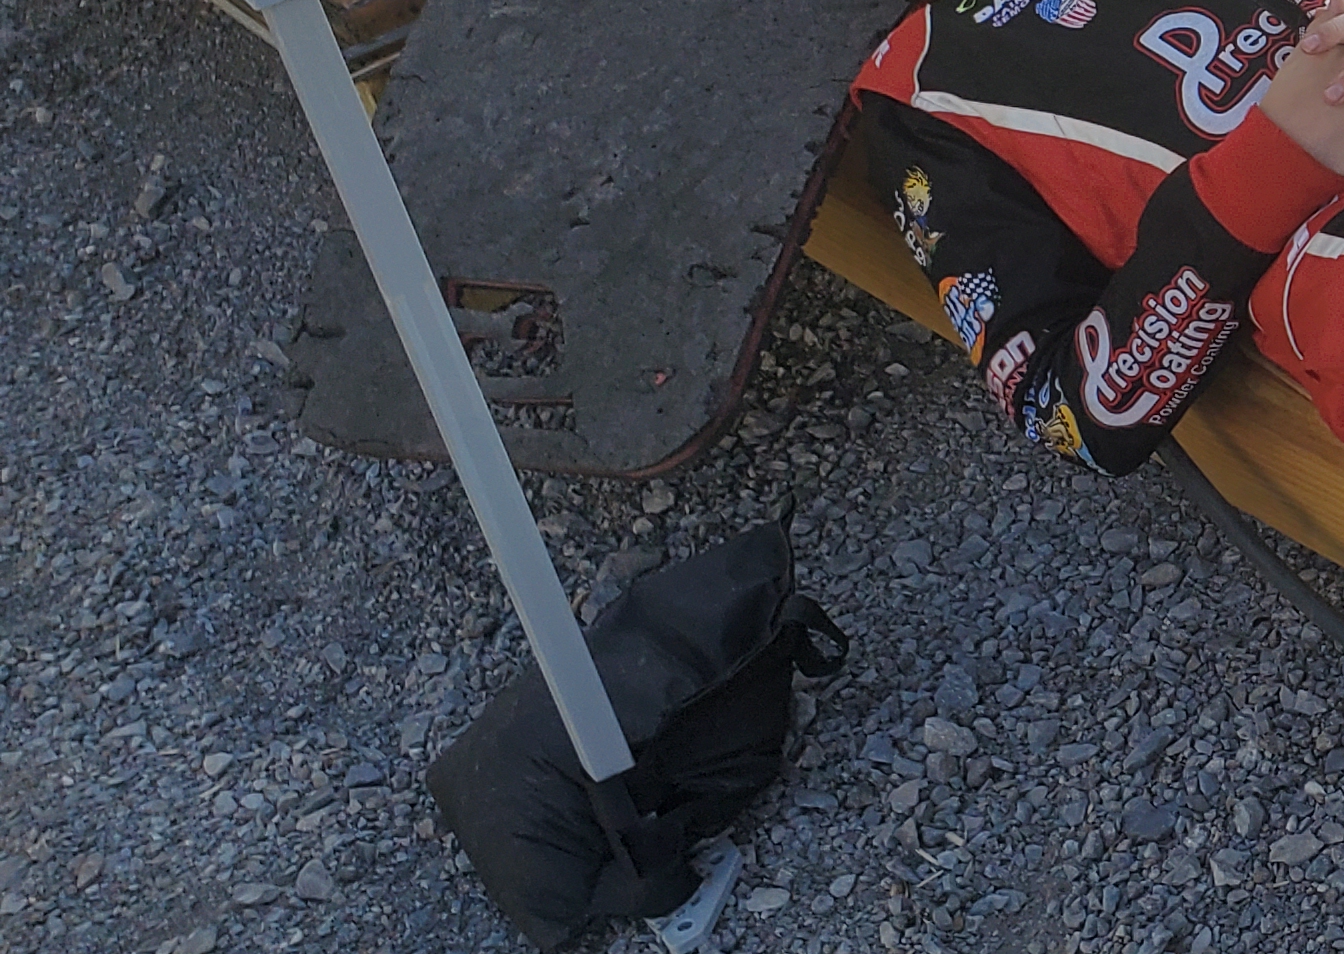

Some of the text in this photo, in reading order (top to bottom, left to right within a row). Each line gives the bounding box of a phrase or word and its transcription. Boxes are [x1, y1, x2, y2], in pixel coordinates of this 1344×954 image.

[1078, 269, 1206, 412] Precision
[1149, 320, 1239, 425] Powder Coating
